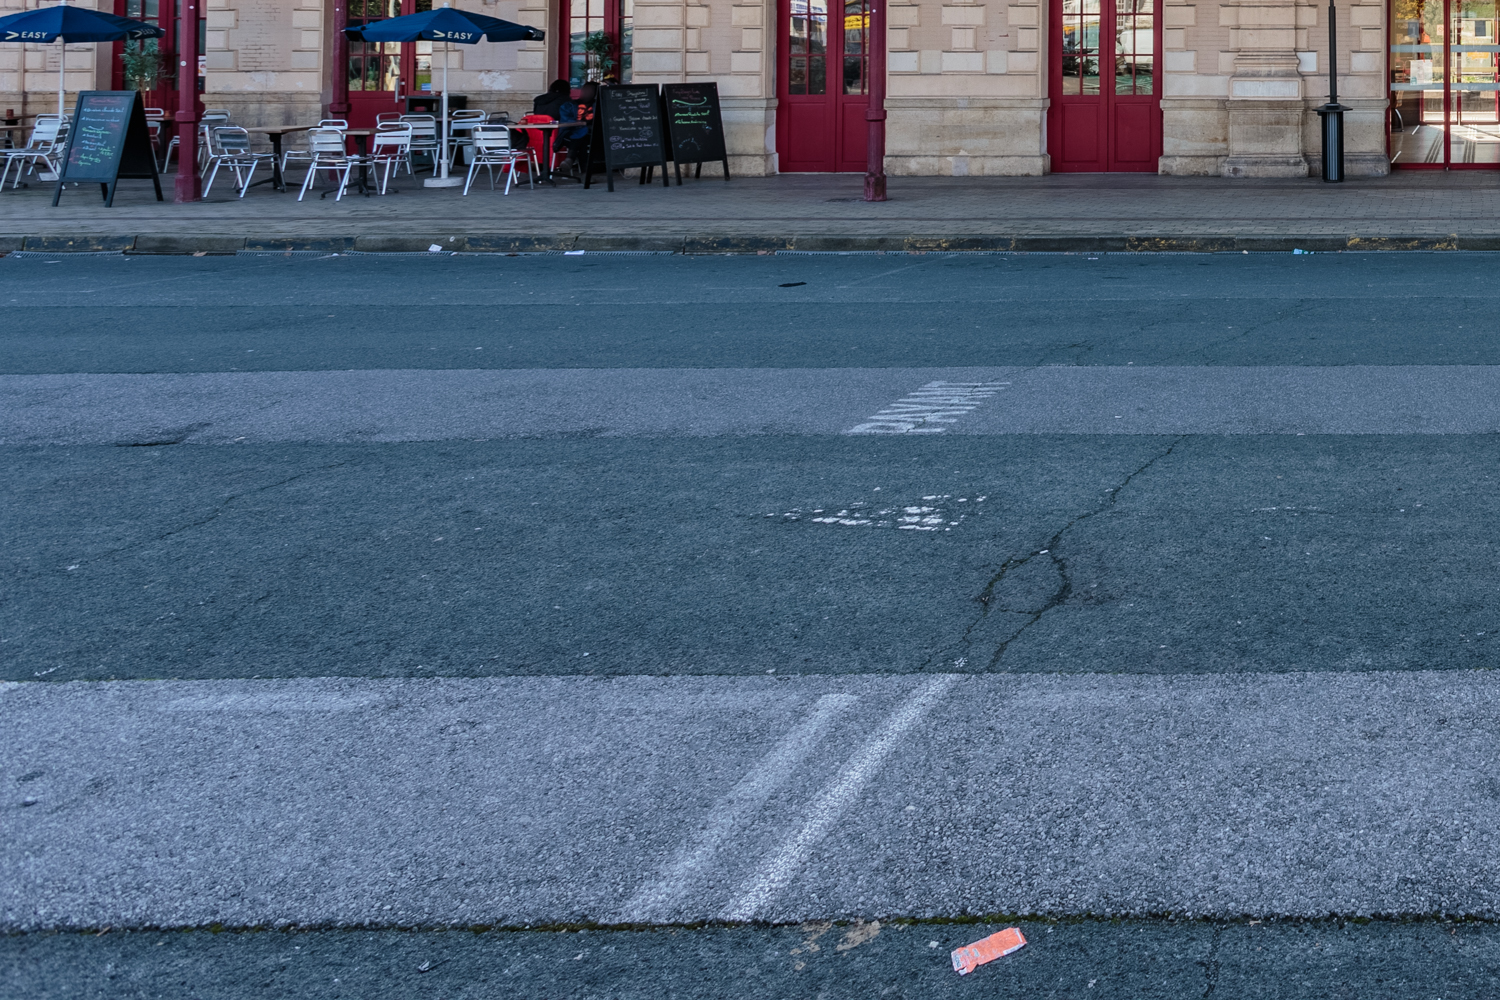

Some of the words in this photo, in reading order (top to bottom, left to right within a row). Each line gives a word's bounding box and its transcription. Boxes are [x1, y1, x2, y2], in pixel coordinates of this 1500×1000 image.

[21, 31, 48, 39] EASY
[447, 31, 473, 40] EASY
[848, 380, 1011, 434] PAYANT
